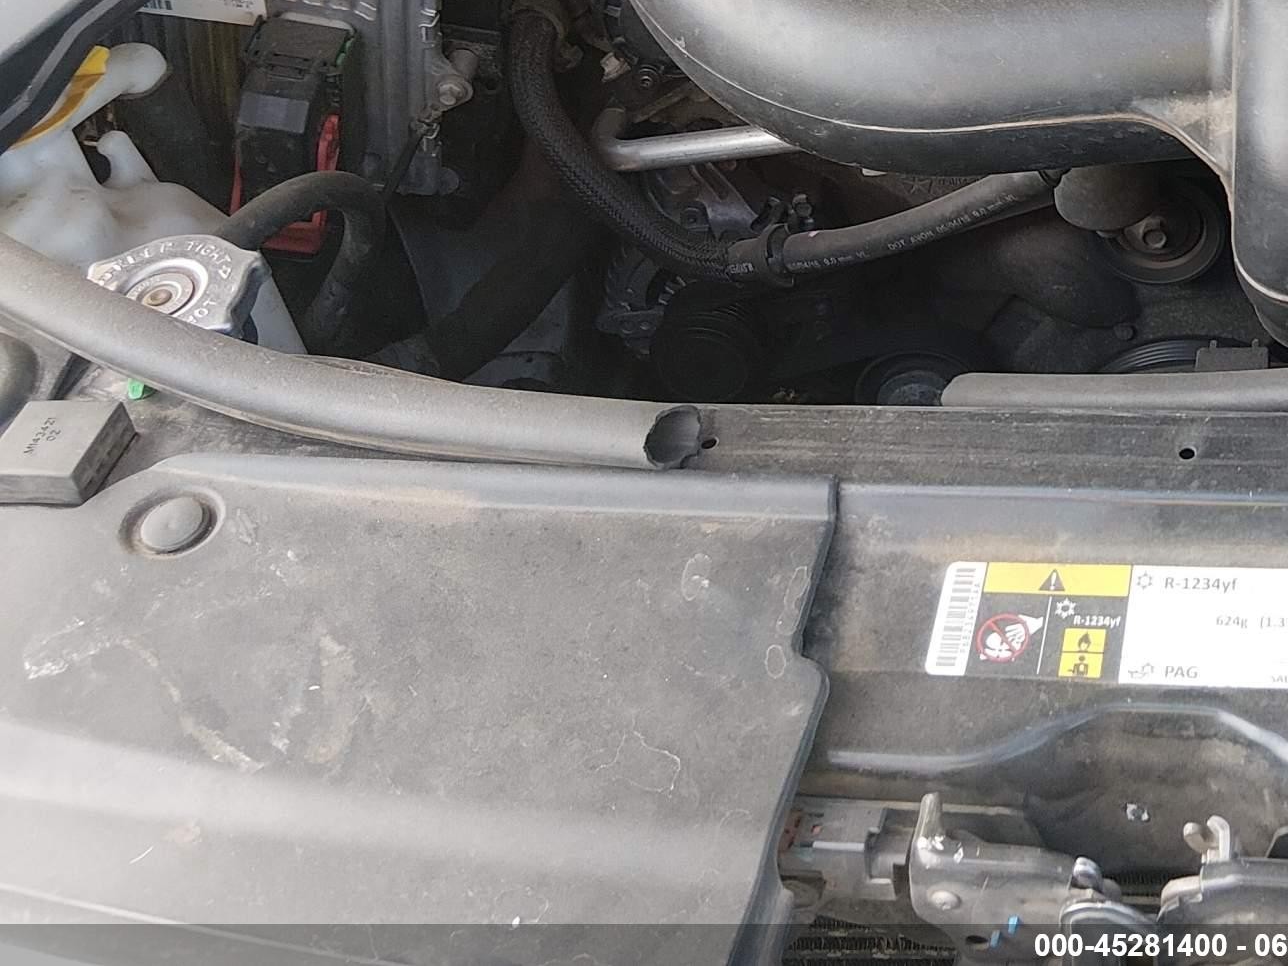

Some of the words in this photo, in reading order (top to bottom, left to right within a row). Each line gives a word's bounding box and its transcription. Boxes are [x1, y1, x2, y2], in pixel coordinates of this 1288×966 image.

[46, 430, 61, 441] 02
[1164, 577, 1238, 593] R-1234yf
[1073, 615, 1121, 629] R-1234yf
[1215, 616, 1248, 629] 624g
[1164, 665, 1198, 679] PAG
